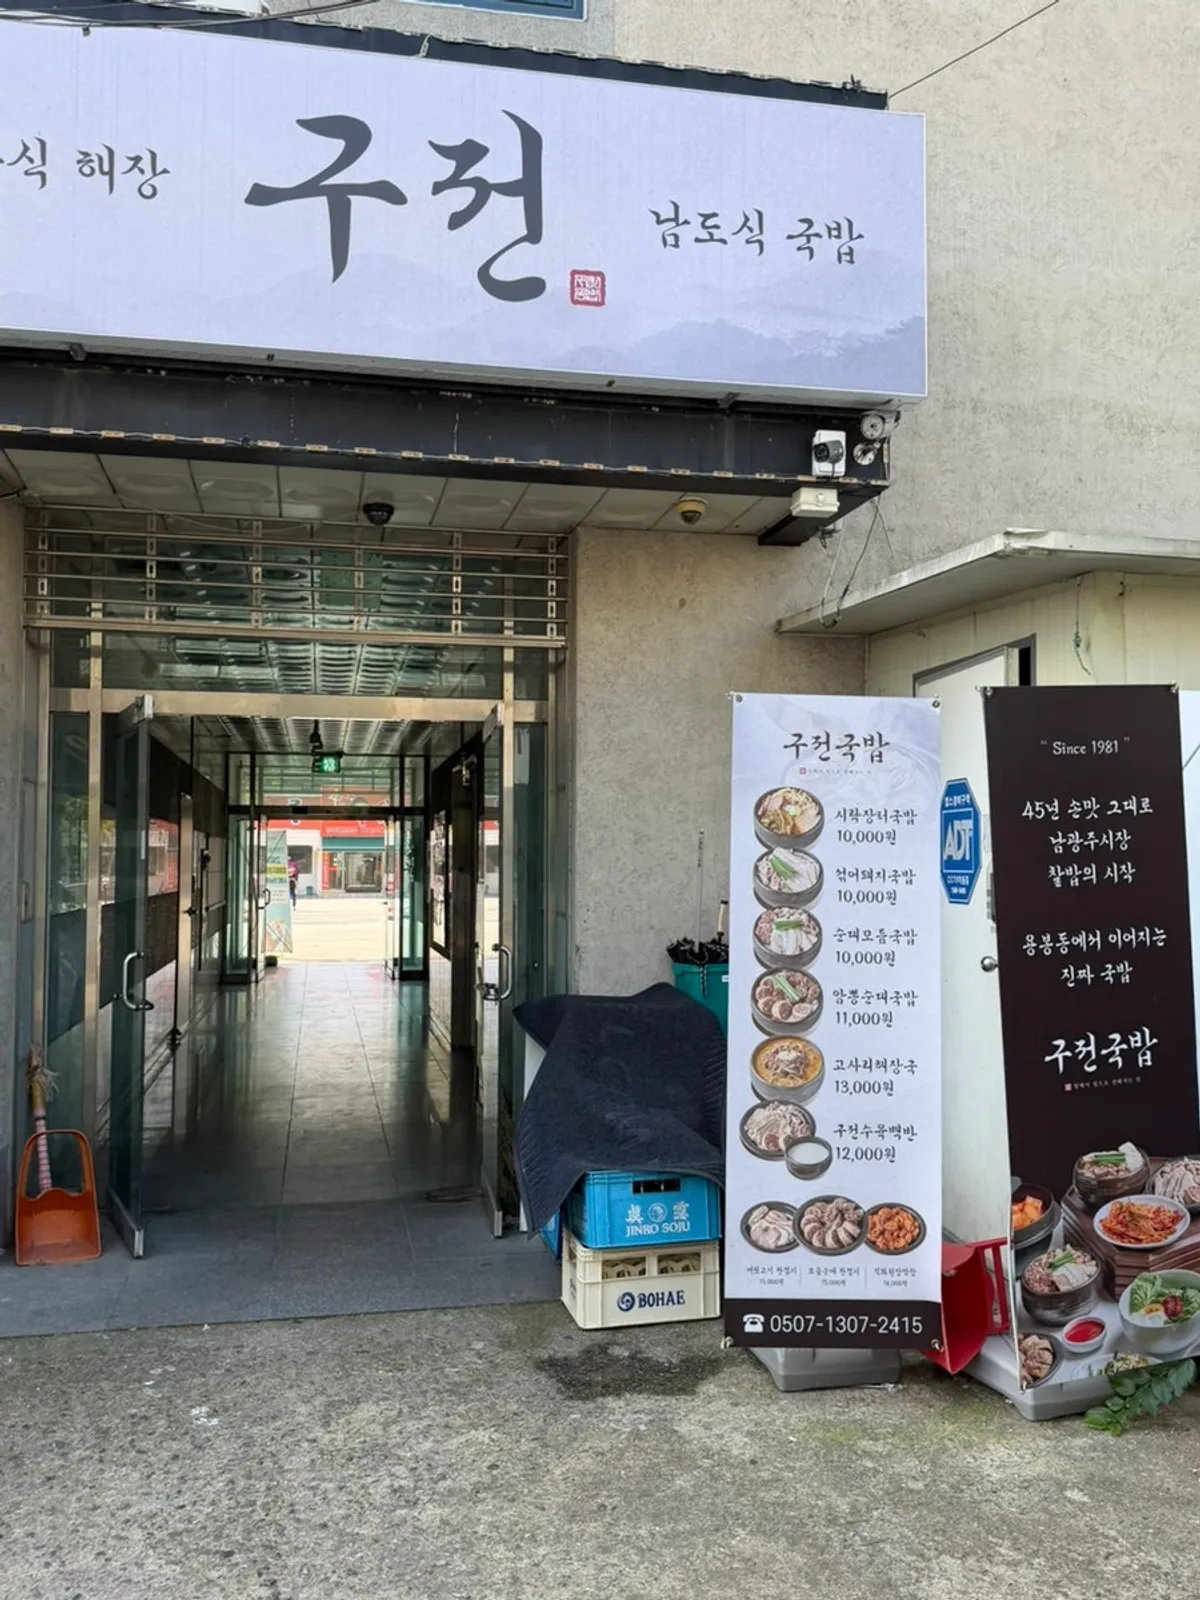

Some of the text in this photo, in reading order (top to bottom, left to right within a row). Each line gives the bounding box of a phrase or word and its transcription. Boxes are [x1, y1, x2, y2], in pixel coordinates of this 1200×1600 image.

[0, 136, 171, 200] 식 해장
[243, 108, 547, 303] 구전
[647, 199, 865, 265] 남도식 국밥
[782, 729, 890, 764] 구전국밥
[1052, 739, 1120, 755] Since 1981
[1022, 795, 1154, 821] 45년 손맛 그대로
[837, 829, 897, 846] 10,000원
[943, 819, 973, 861] ADT
[1049, 828, 1132, 854] 남광주시장
[834, 866, 917, 886] 섞어돼지국밥
[1103, 862, 1137, 885] 시작
[837, 888, 897, 906] 10,000원
[833, 926, 919, 946] 순대모듬국밥
[1022, 926, 1168, 957] 용봉동에서 이어지는
[836, 950, 896, 967] 10,000원
[1060, 960, 1134, 988] 진짜 국밥
[832, 987, 919, 1008] 암뽕순대국밥
[836, 1011, 893, 1028] 11,000원
[1044, 1026, 1159, 1075] 구전국밥
[833, 1056, 919, 1076] 고사리해장국
[834, 1079, 894, 1097] 13,000원
[833, 1122, 918, 1142] 구전수육백반
[836, 1145, 896, 1163] 12,000원
[625, 1221, 690, 1239] JINRO SOJU
[638, 1290, 686, 1308] BOHAE
[769, 1314, 923, 1334] 0507-1307-2415
